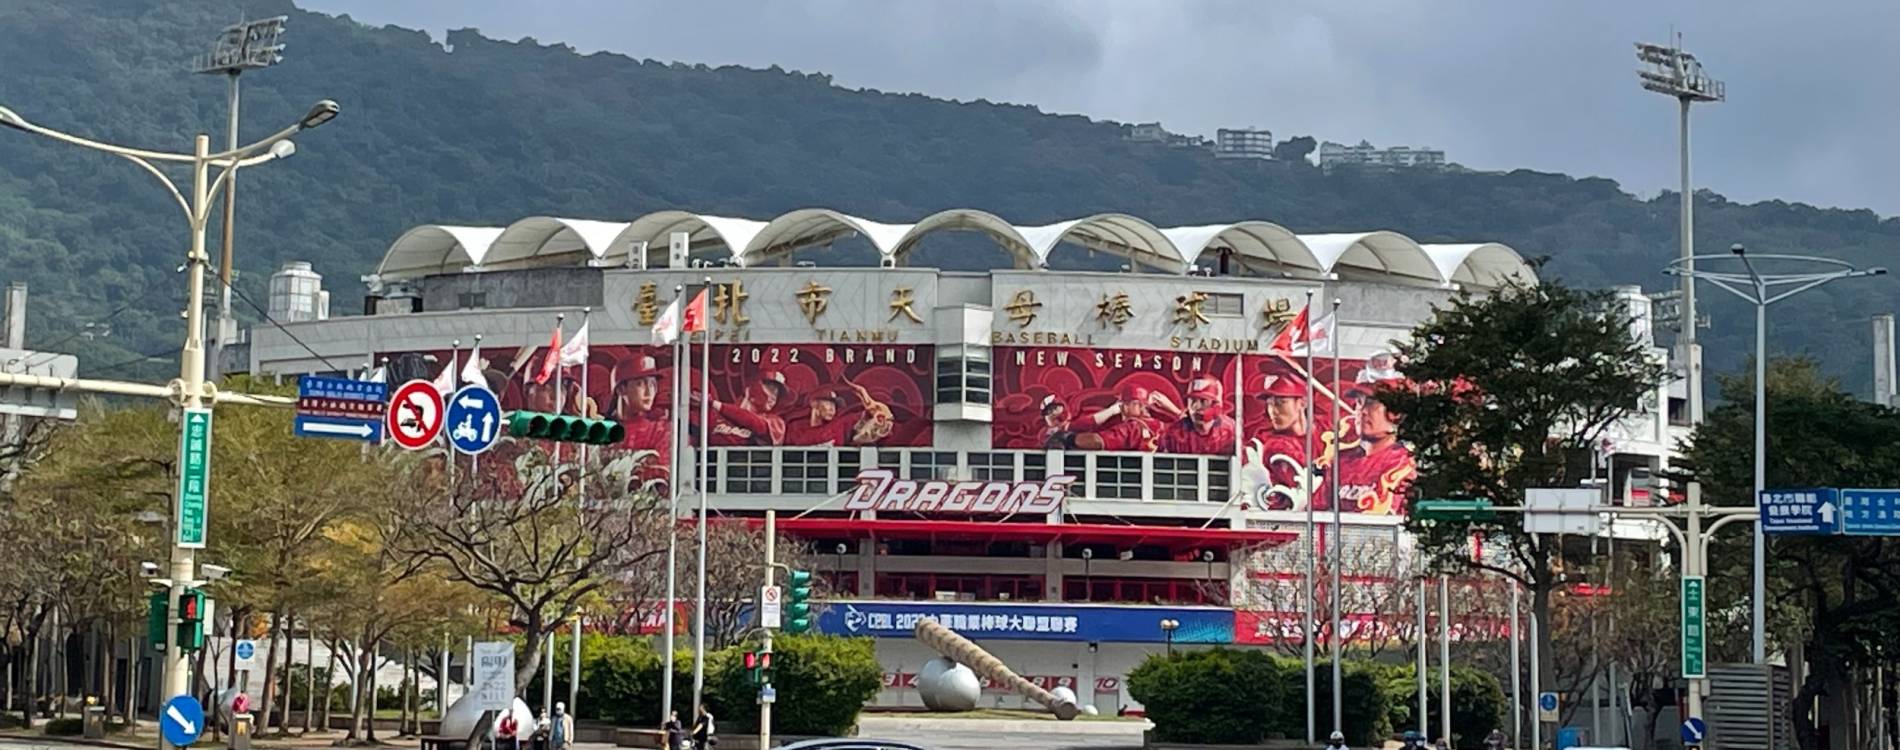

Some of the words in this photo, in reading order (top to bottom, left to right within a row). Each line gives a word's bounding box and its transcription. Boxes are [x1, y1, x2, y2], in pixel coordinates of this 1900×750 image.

[816, 329, 898, 342] TIANMU
[991, 330, 1096, 346] BASEBALL
[1170, 335, 1259, 351] STADIUM
[732, 348, 799, 363] 2022
[825, 348, 916, 363] BRAND
[1016, 351, 1069, 367] NEW
[1095, 353, 1202, 372] SEASON
[845, 468, 1078, 514] DRAGONS
[896, 613, 926, 630] 202
[1095, 677, 1119, 689] 10
